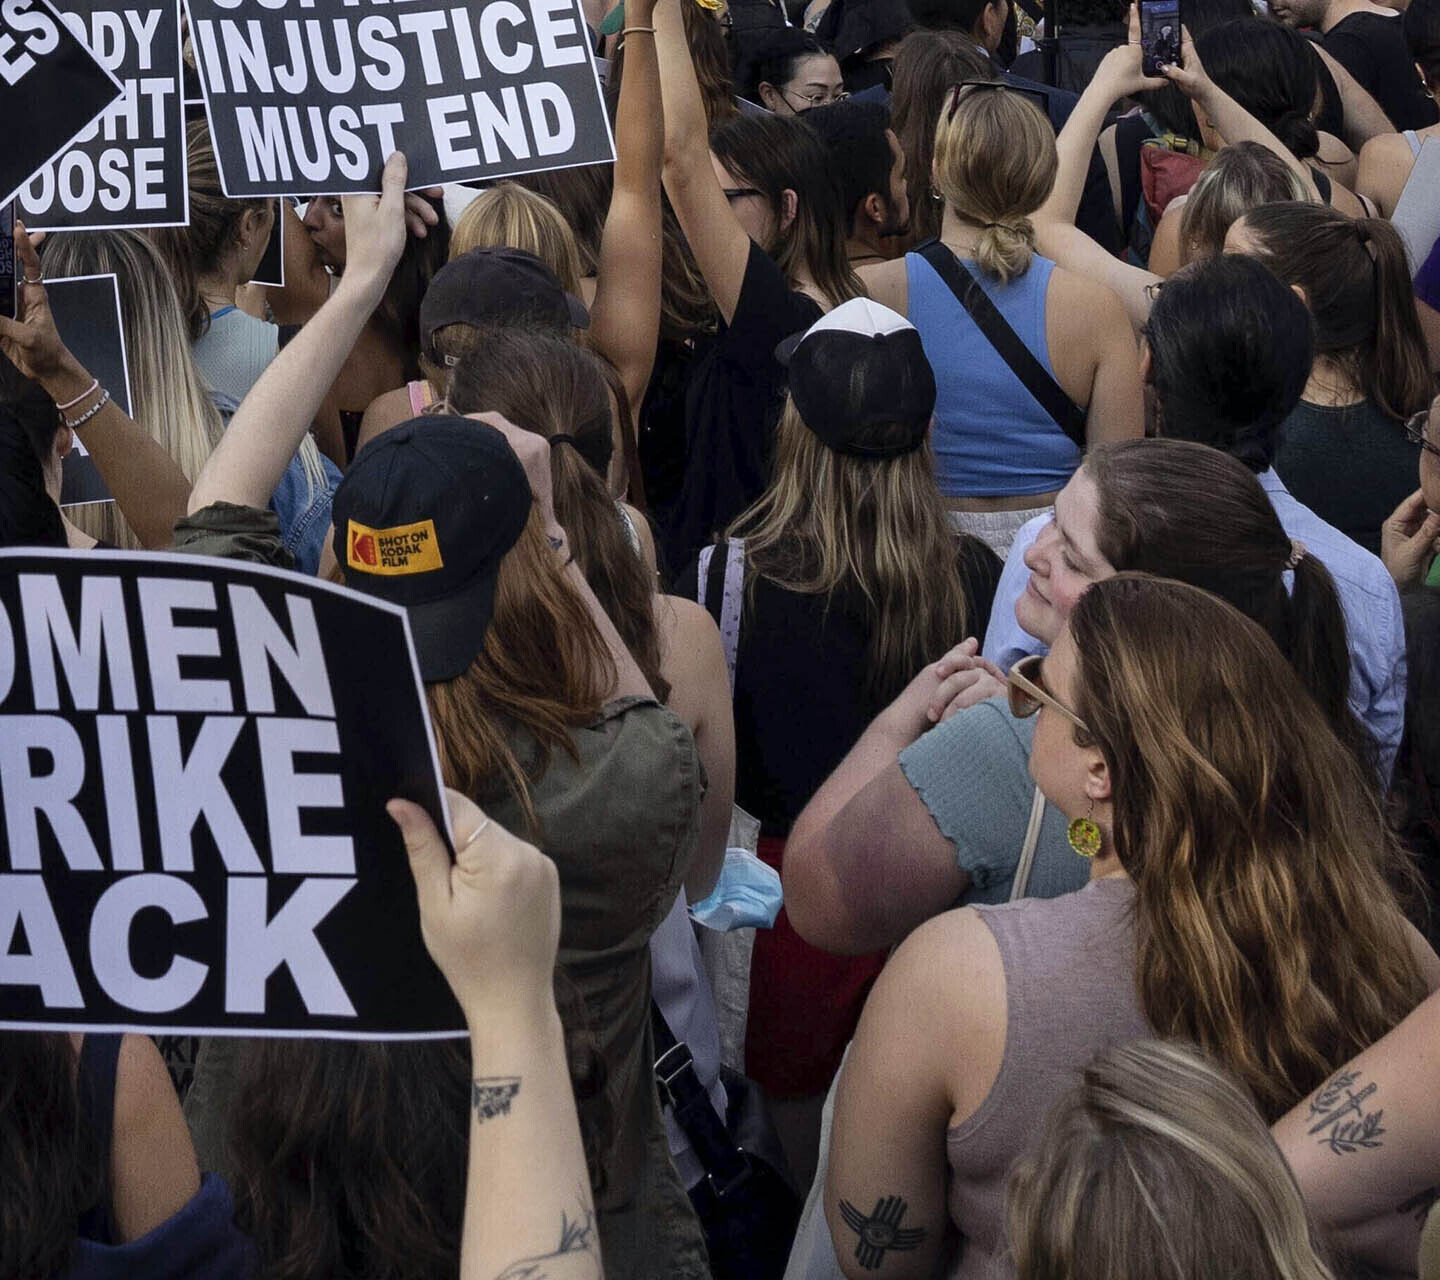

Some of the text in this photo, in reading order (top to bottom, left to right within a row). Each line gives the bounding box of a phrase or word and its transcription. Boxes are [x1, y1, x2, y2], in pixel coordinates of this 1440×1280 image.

[235, 81, 575, 182] MUST END
[378, 530, 428, 546] SHOT ON
[380, 544, 422, 557] KODAK
[382, 557, 408, 567] FILM
